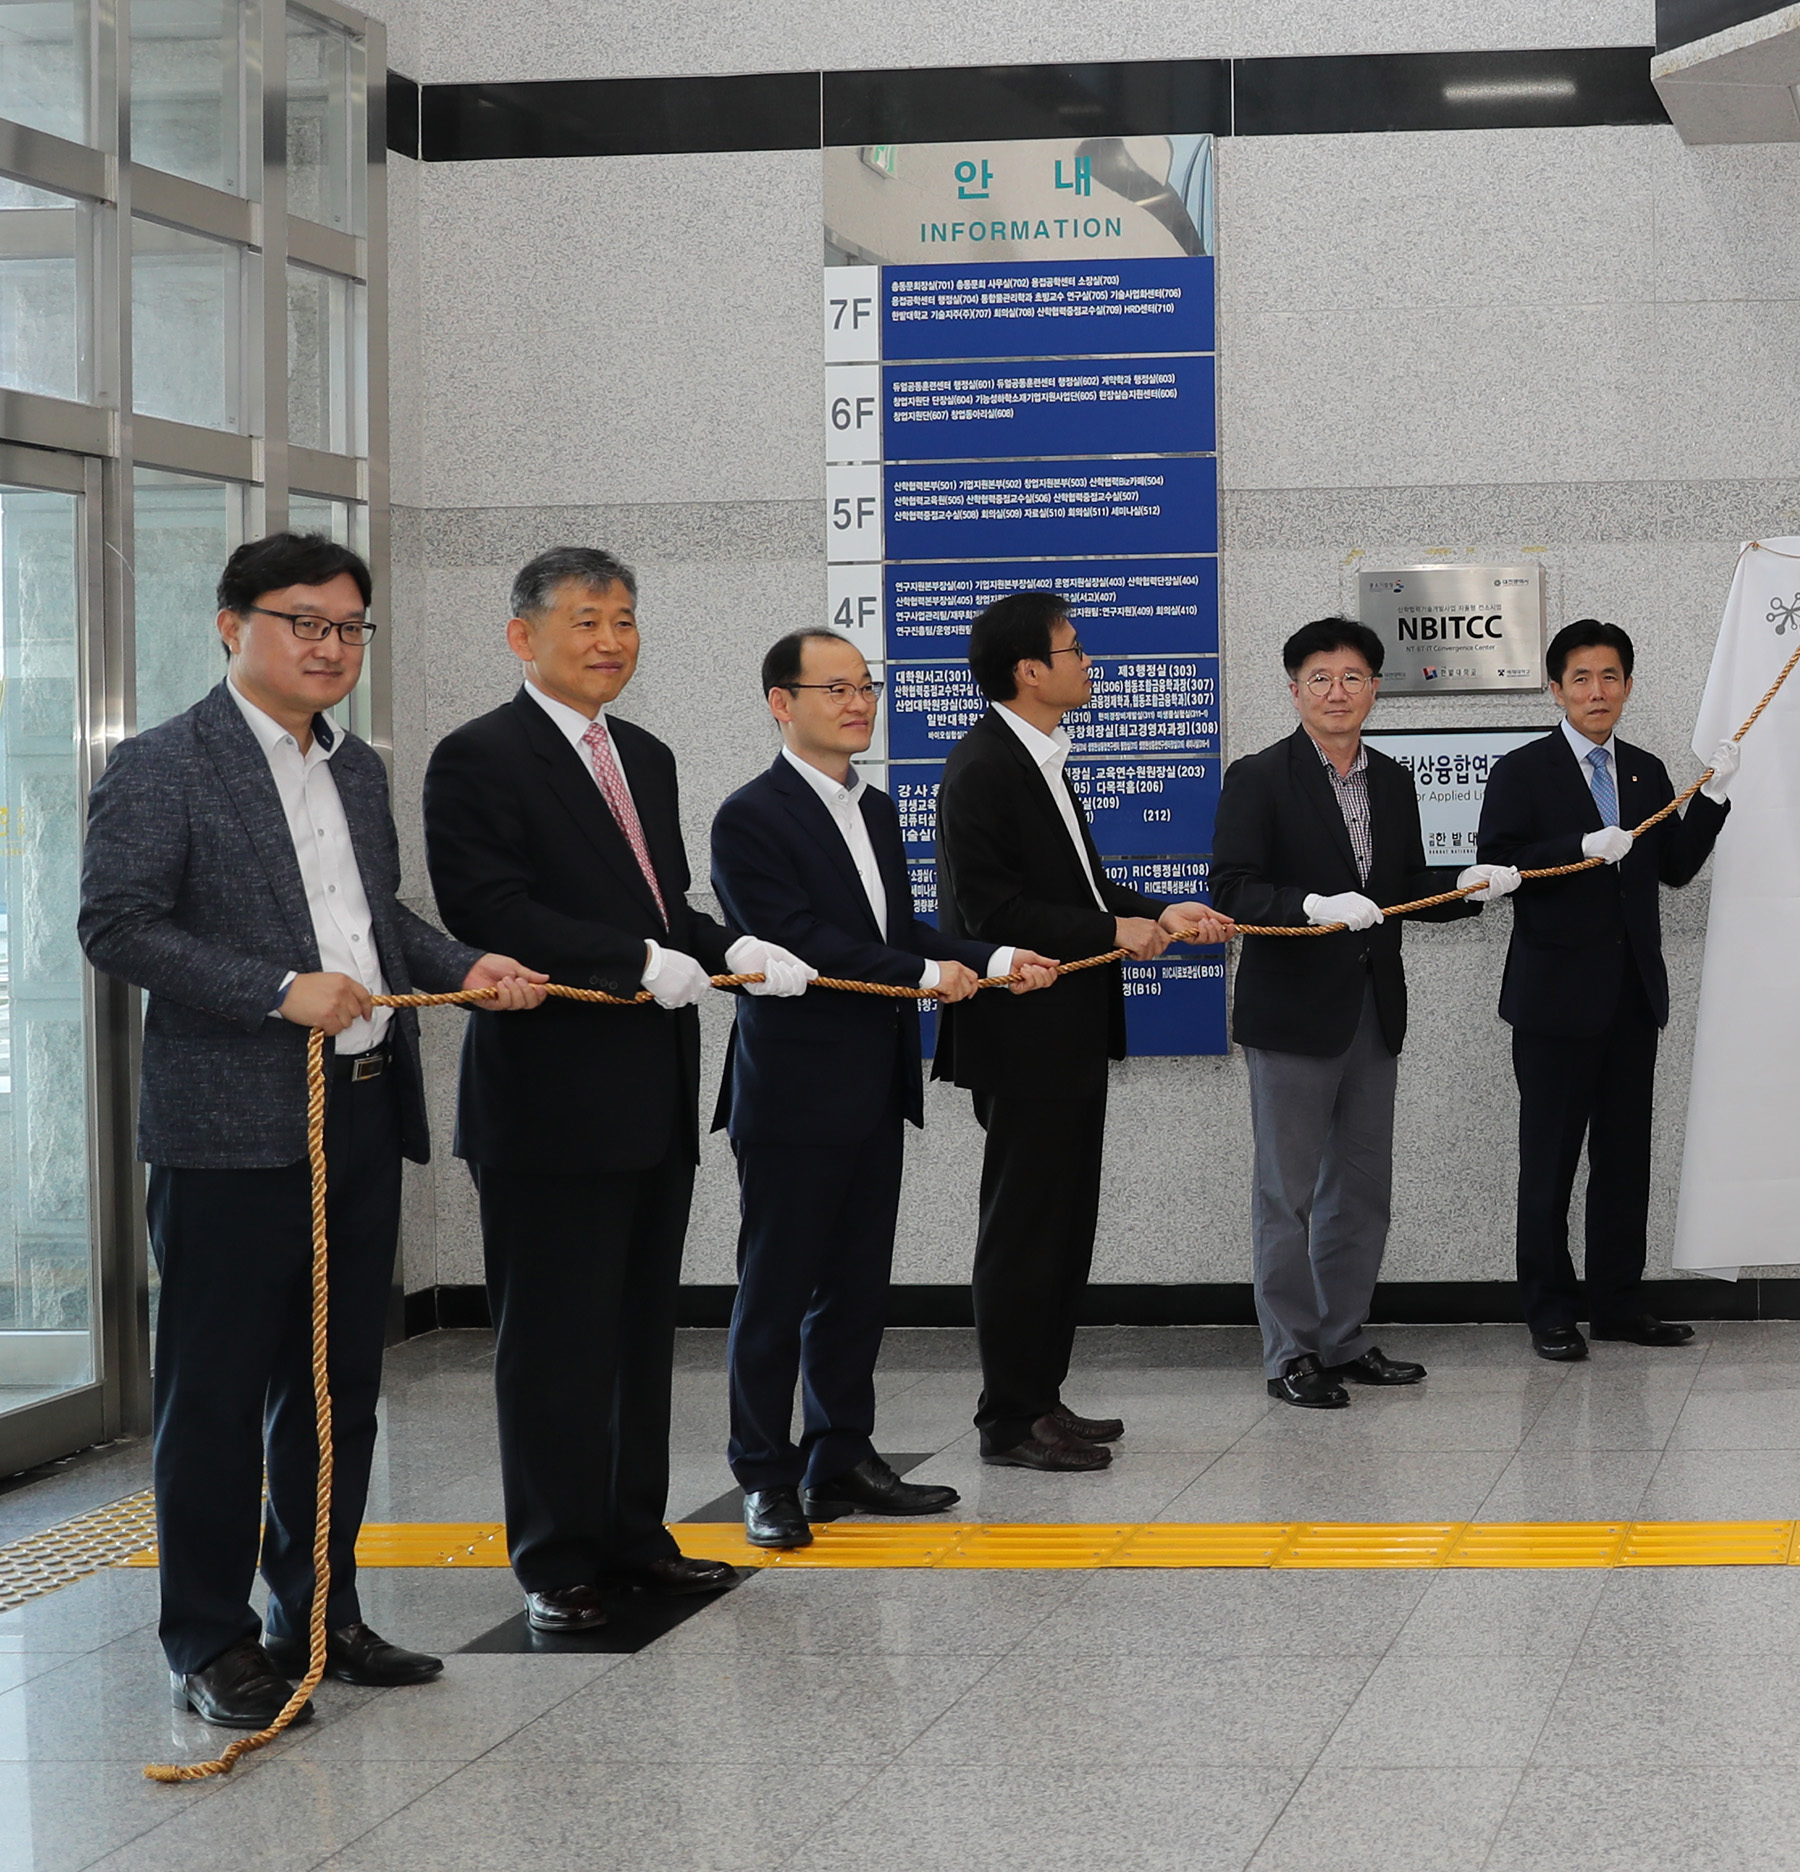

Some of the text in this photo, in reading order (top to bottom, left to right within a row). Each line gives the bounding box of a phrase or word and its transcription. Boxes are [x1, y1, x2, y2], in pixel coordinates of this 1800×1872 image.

[955, 155, 1091, 199] 안 내
[921, 217, 1122, 242] INFORMATION
[988, 278, 1029, 289] 사무실(702)
[1078, 275, 1119, 286] 소장실(703)
[938, 294, 979, 305] 행정실(704)
[1067, 290, 1108, 301] 연구실(705)
[1110, 288, 1181, 300] 기술사업화센터(706)
[829, 298, 872, 330] 7F
[892, 310, 928, 321] 한밭대학교
[931, 308, 991, 319] 기술지주(주)(707)
[994, 307, 1035, 318] 회의실(708)
[1124, 303, 1174, 314] HRD센터(710)
[893, 374, 1175, 392] 듀얼공동훈련센터 행정실(601) 듀얼공동훈련센터 행정실(602) 계약학과 행정실(603)
[893, 396, 930, 407] 창업지원단
[932, 395, 973, 405] 단장실(604)
[1099, 388, 1177, 400] 현장실습지원센터(606)
[831, 397, 874, 430] 6F
[894, 408, 1014, 422] 창업지원단(607) 창업동아리실(608)
[894, 476, 1163, 491] 산학협력본부(501) 기업지원본부(502) 창업지원본부(503) 산학협력Biz카페(504)
[894, 495, 964, 506] 산학협력교육원(505)
[833, 497, 876, 530] 5F
[981, 508, 1022, 519] 회의실(509)
[1024, 508, 1065, 518] 자료실(510)
[1068, 506, 1109, 517] 회의실(511)
[1111, 505, 1160, 516] 세미나실(512)
[896, 575, 1198, 592] 연구지원본부장실(401) 기업지원본부장실(402) 운영지원실장실(403) 산학협력단장실(404)
[896, 595, 975, 607] 산학협력본부장실(405)
[834, 597, 877, 628] 4F
[895, 609, 984, 622] 연구사업관리팀/재무회
[1156, 604, 1198, 617] 회의실(410)
[1398, 615, 1503, 641] NBITCC
[896, 669, 971, 684] 대학원서고(301)
[1117, 664, 1167, 678] 제3행정실
[1169, 663, 1197, 677] (303)
[894, 684, 974, 698] 산학협력중점교수연구실
[1089, 680, 1124, 694] 실(306)
[1124, 678, 1214, 693] 협동조합금융학과장(307)
[895, 693, 1214, 712] 산업대학원장실(305) 금융경제학과,협동조합금융학과](307)
[926, 713, 984, 726] 일반대학원
[1059, 710, 1092, 724] 실(310)
[927, 730, 968, 740] 바이오실험실(
[1059, 721, 1218, 739] 동창회장실[최고경영자과정](308)
[1393, 754, 1504, 785] 상융합연
[1072, 780, 1164, 795] 05) 다목적홀(206)
[1429, 790, 1471, 802] Applied
[1474, 790, 1484, 800] Li
[1079, 796, 1120, 811] 실(209)
[899, 813, 936, 827] 컴퓨터실
[1143, 809, 1171, 822] (212)
[1102, 866, 1128, 880] 107)
[1132, 862, 1209, 878] RIC행정실(108)
